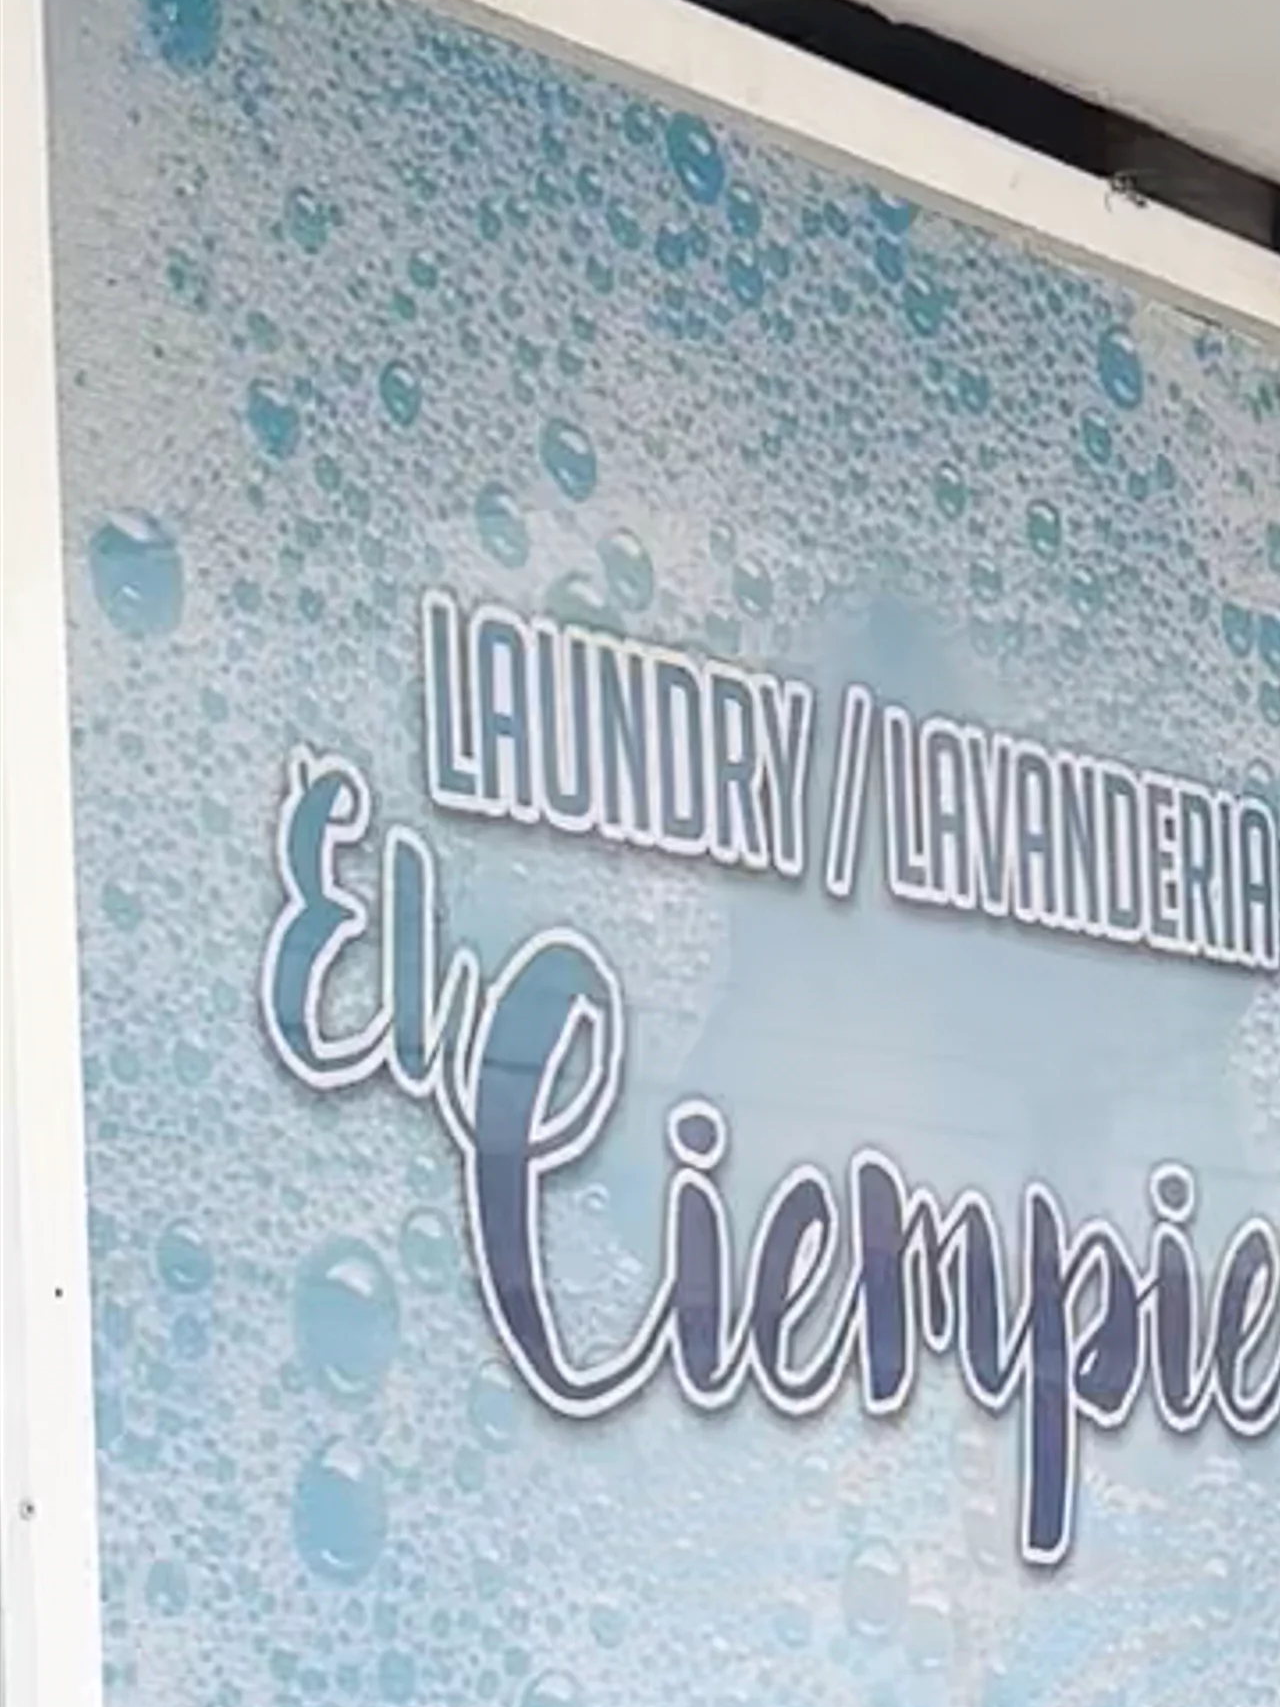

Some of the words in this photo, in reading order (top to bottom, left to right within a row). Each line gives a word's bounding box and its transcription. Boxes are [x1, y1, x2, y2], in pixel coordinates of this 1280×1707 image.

[262, 749, 478, 1093] El
[421, 590, 812, 875] LAUNDRY
[882, 704, 1279, 969] LAVANDERIA
